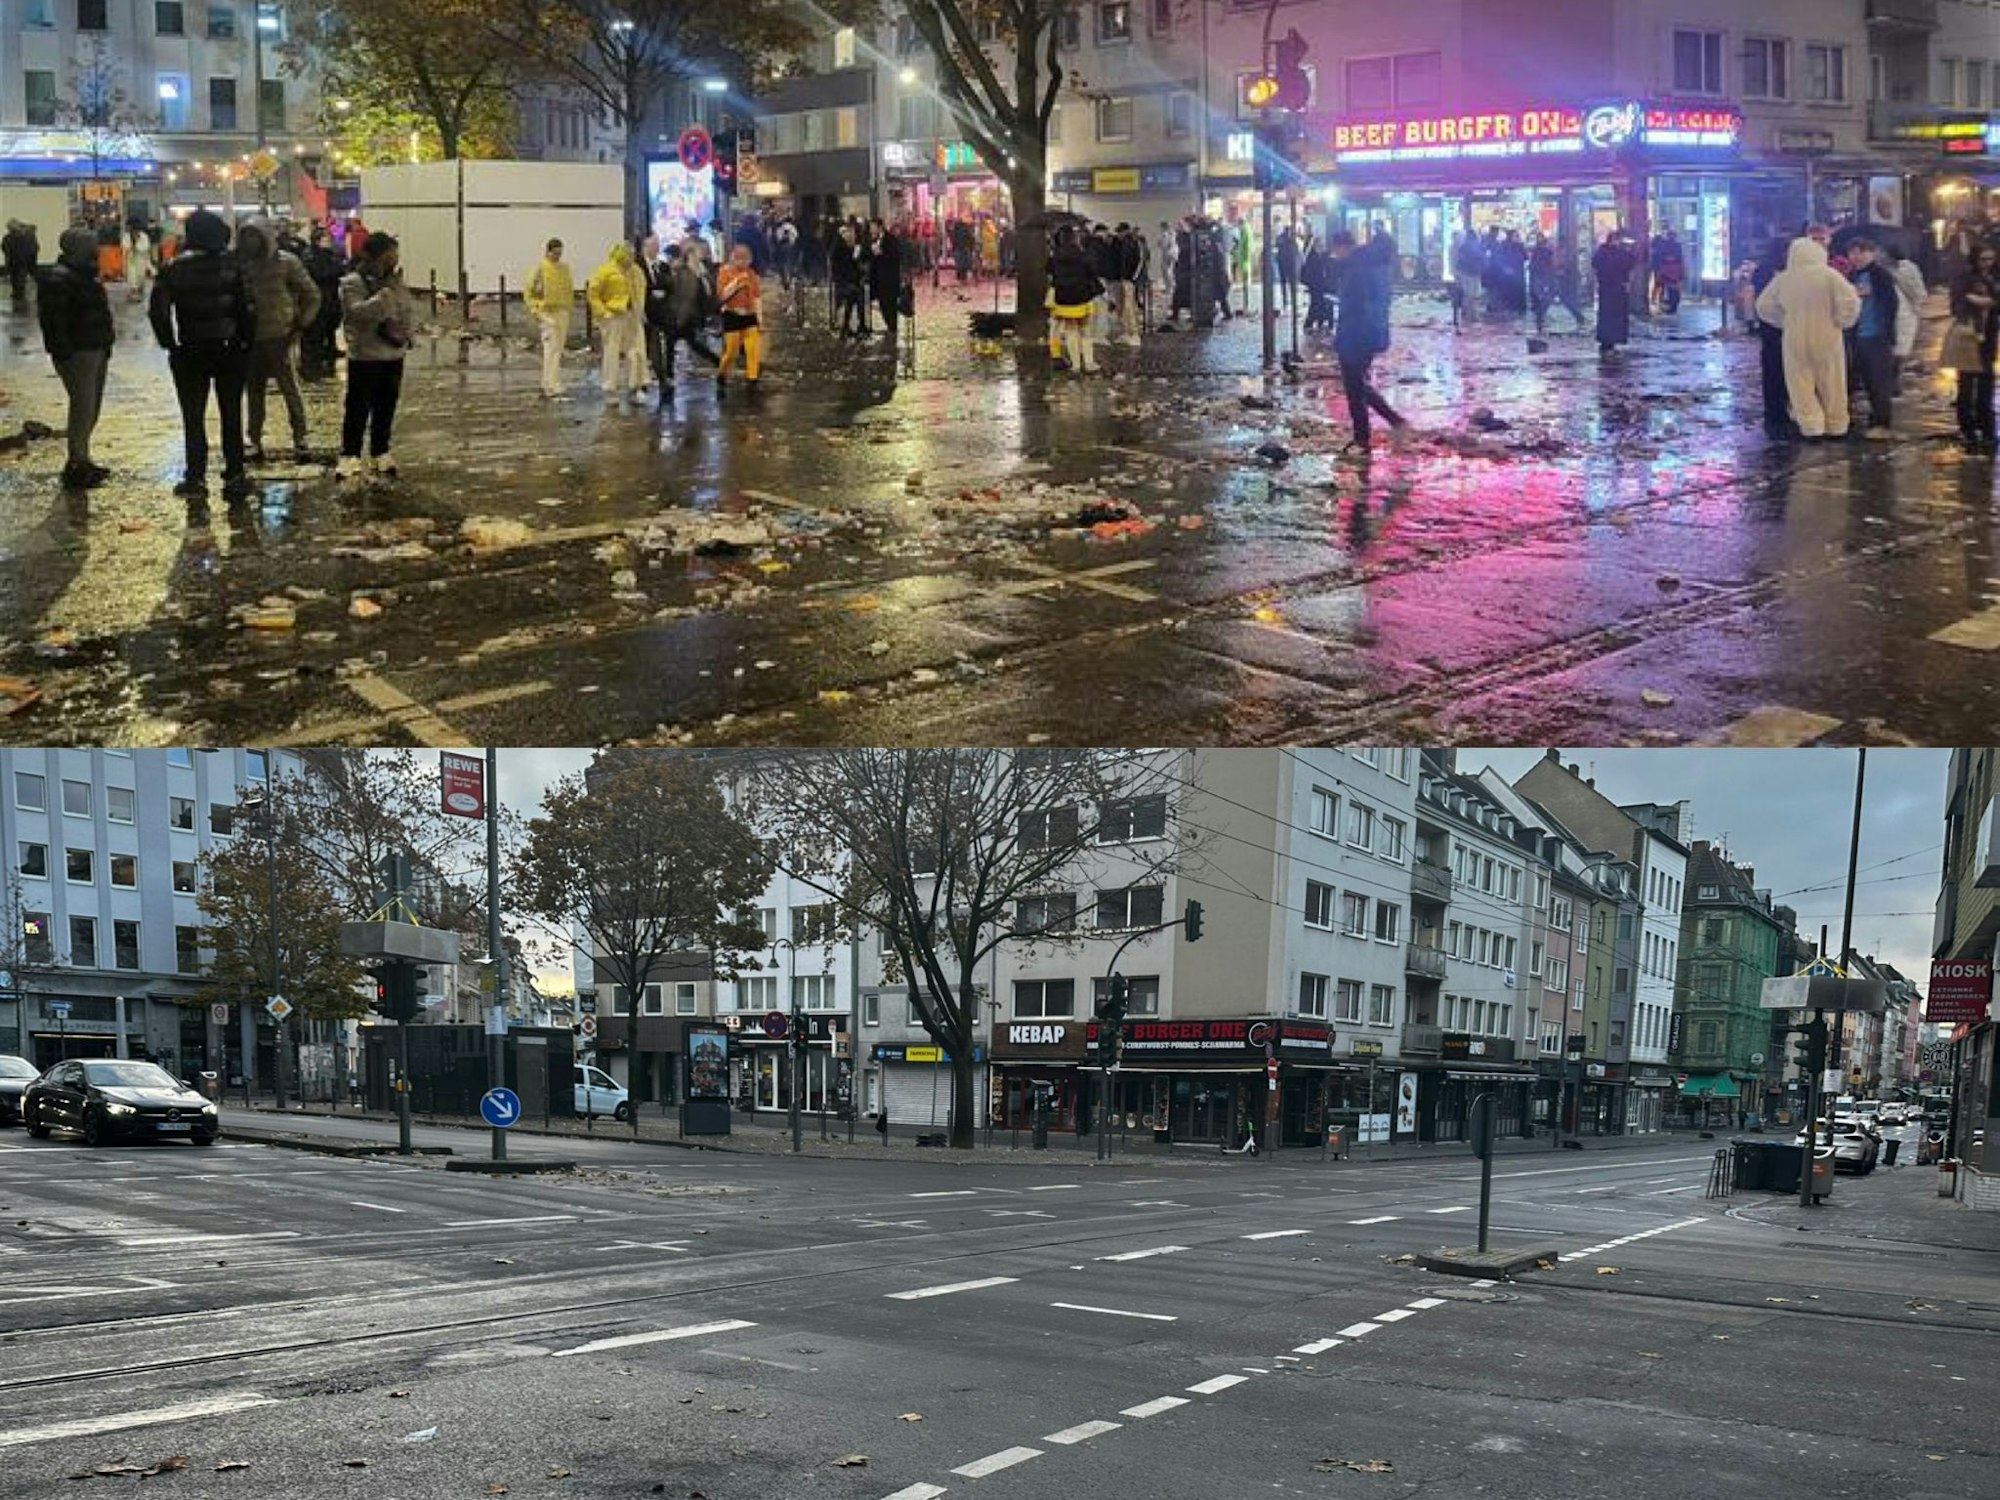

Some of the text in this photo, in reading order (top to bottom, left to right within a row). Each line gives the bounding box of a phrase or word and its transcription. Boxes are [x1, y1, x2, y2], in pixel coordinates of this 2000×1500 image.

[1335, 121, 1397, 148] BEEF
[444, 757, 480, 774] REWE
[1932, 964, 1988, 978] KIOSK
[1009, 1025, 1065, 1043] KEBAP
[1134, 1022, 1204, 1040] BURGER
[1209, 1021, 1247, 1039] ONE
